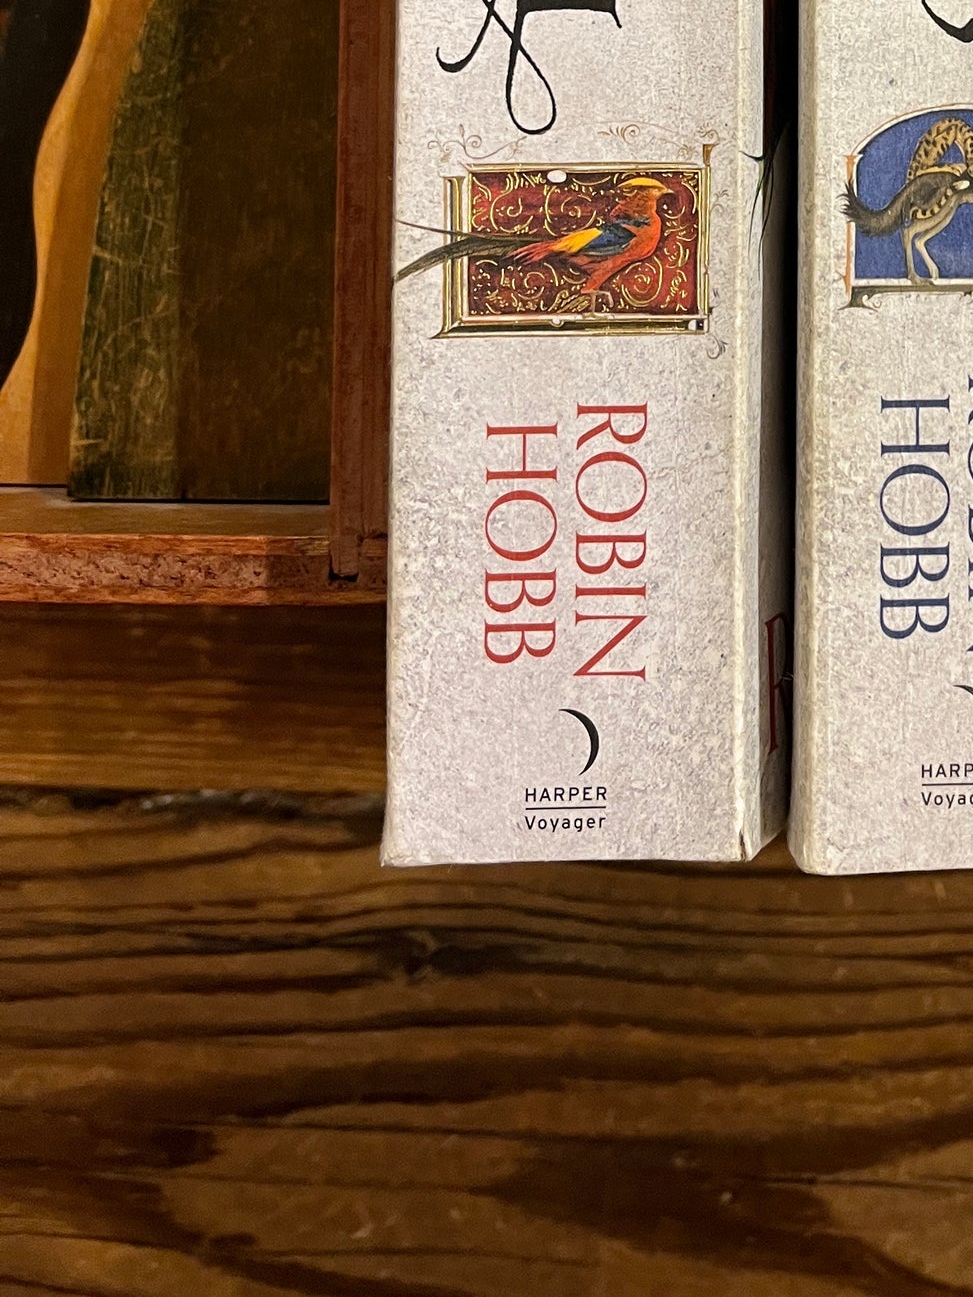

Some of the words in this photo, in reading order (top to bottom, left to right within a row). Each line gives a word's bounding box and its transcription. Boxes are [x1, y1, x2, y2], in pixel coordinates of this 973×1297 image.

[484, 421, 558, 664] HOBB
[573, 402, 648, 682] ROBIN
[880, 395, 950, 639] HOBB
[524, 814, 606, 833] Voyager
[525, 786, 607, 802] HARPER
